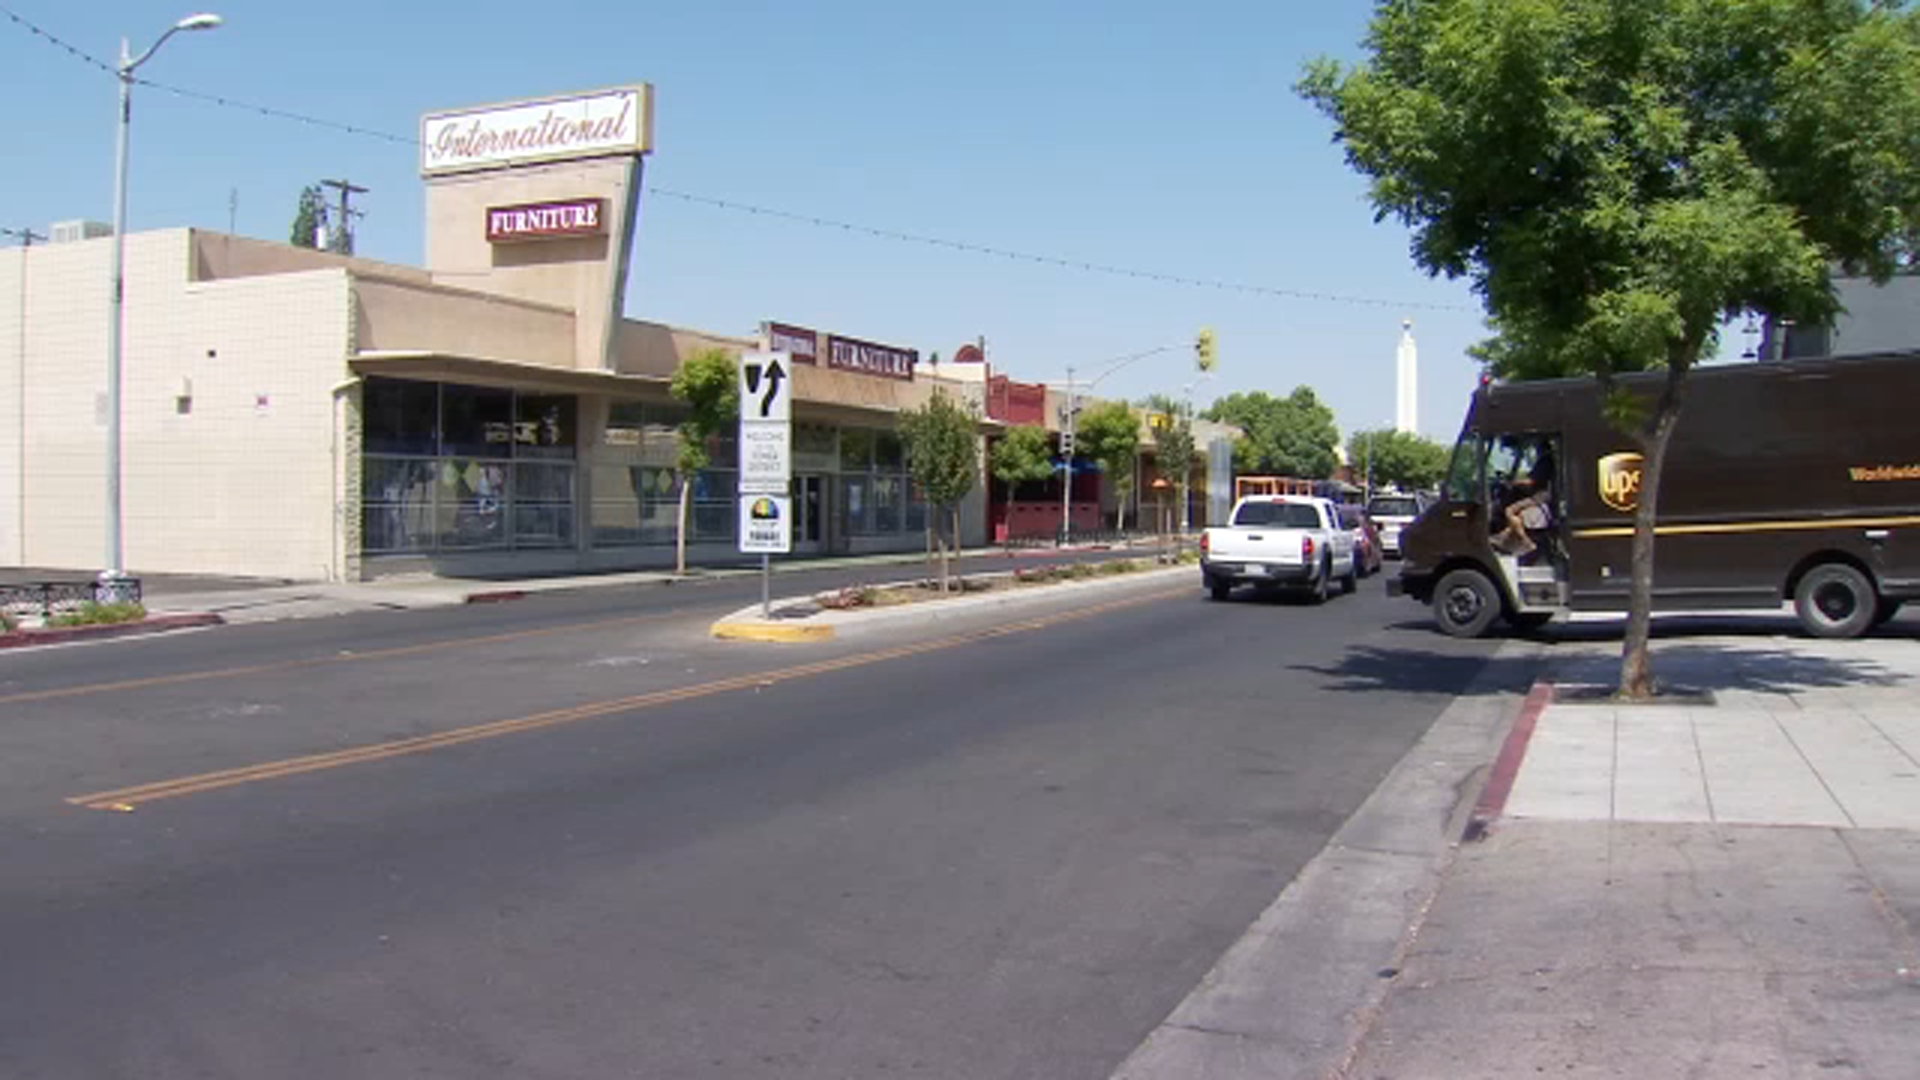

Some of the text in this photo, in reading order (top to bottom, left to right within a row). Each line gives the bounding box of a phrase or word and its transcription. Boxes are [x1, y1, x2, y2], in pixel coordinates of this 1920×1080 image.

[428, 99, 631, 160] International
[491, 203, 599, 235] FURNITURE
[831, 341, 910, 376] FURNITURE
